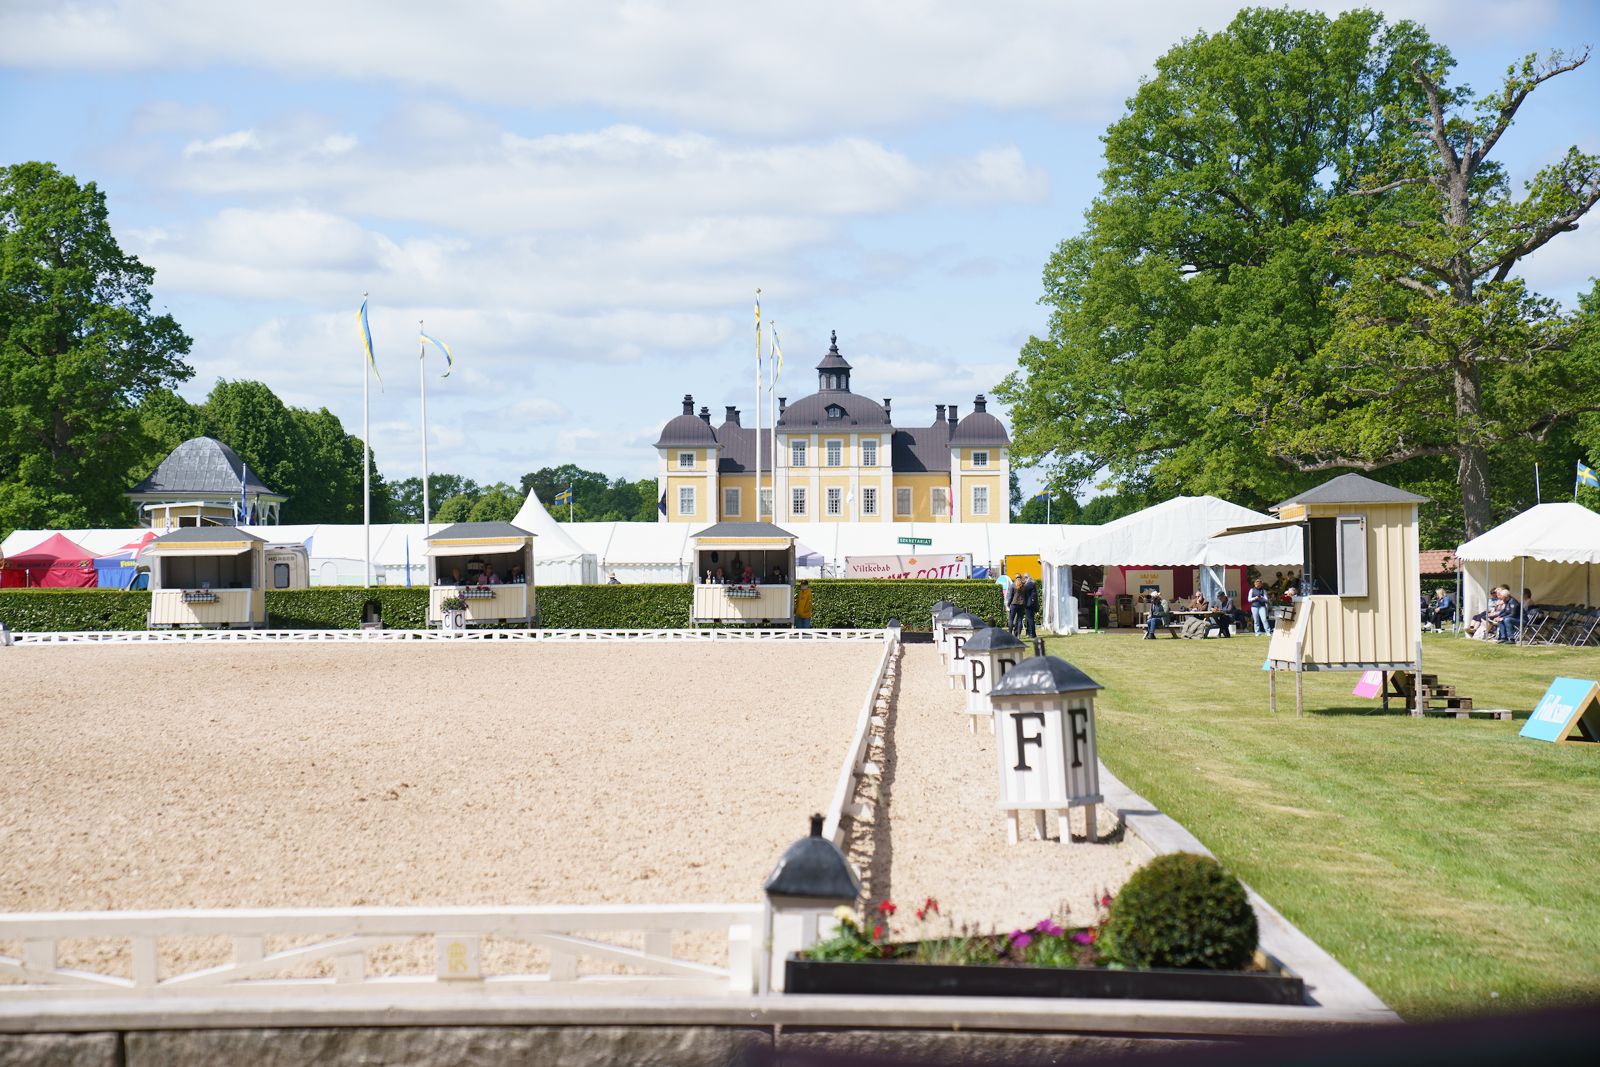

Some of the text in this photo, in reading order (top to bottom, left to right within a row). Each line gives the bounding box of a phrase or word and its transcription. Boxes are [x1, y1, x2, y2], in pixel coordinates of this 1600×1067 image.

[852, 563, 891, 572] Viltkebab
[455, 613, 464, 628] C
[969, 659, 986, 694] P
[1010, 712, 1046, 771] F
[1067, 708, 1088, 768] F
